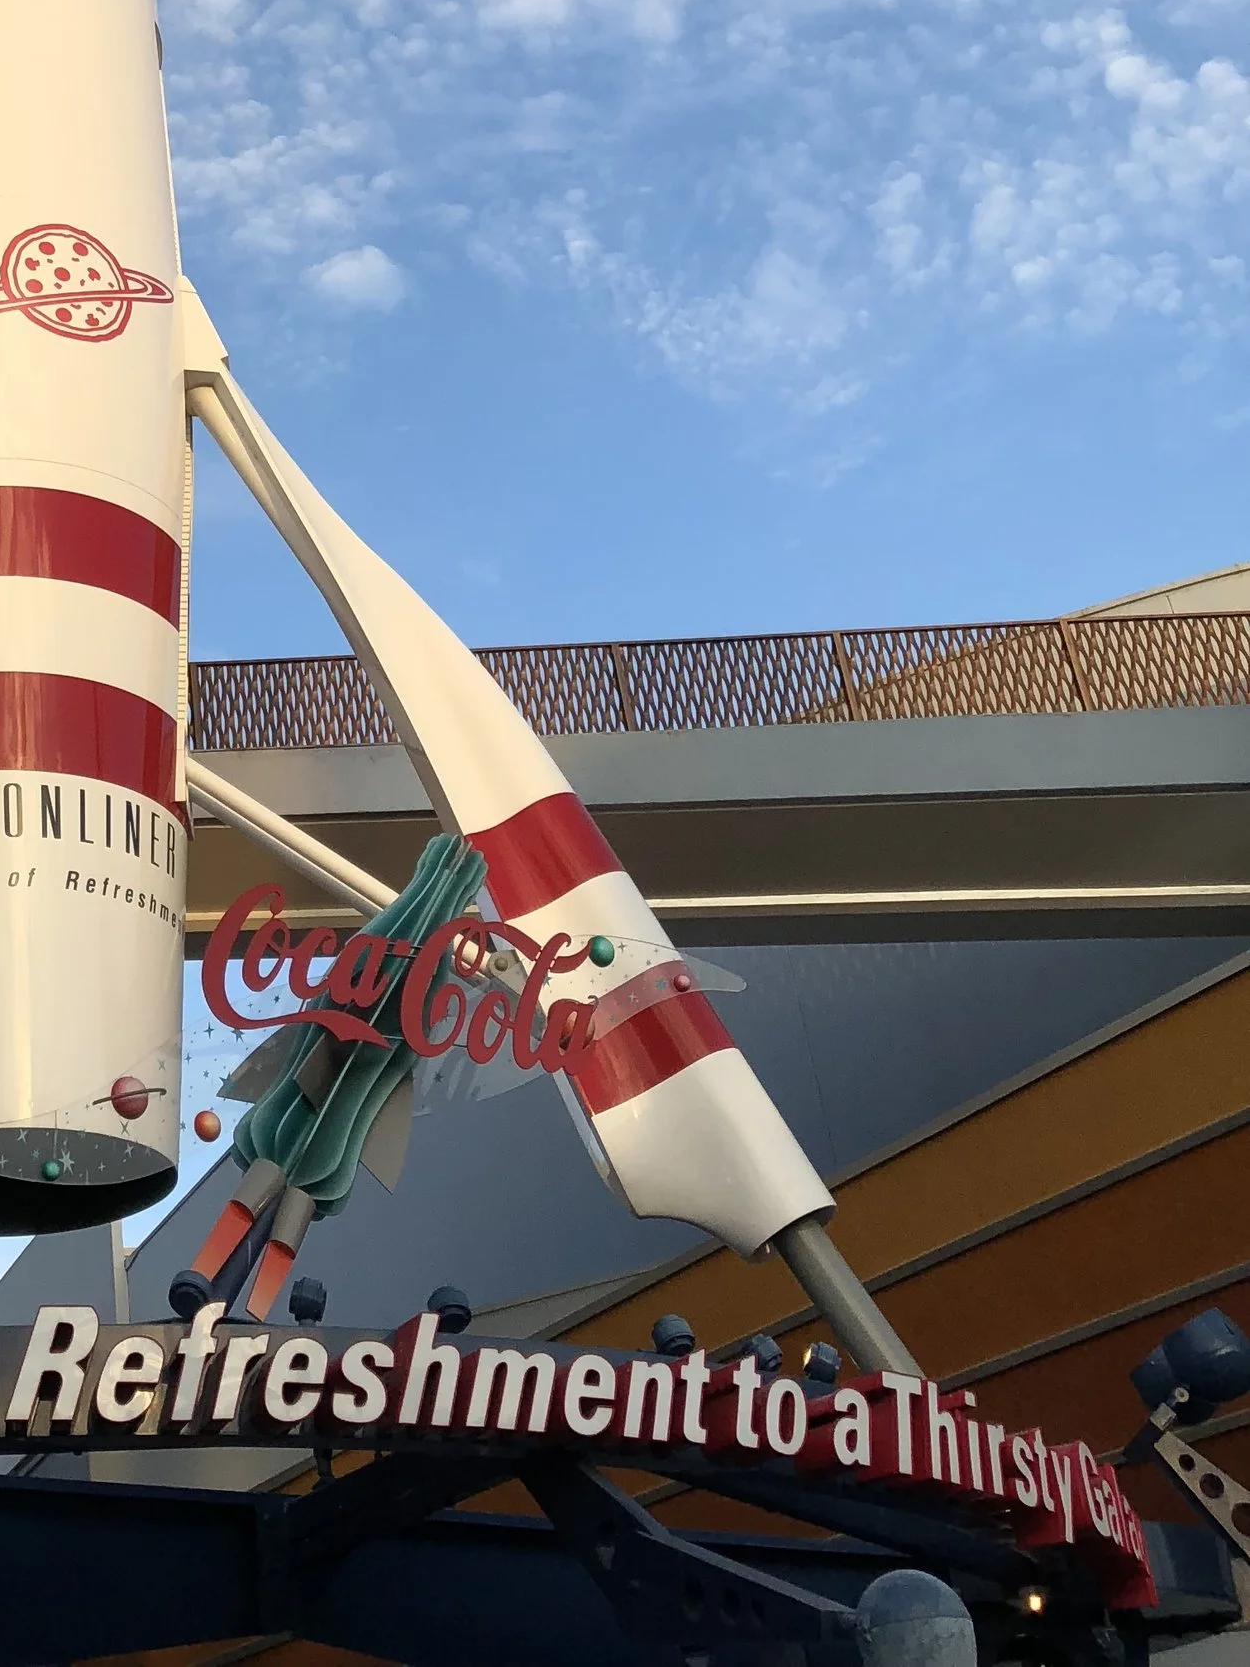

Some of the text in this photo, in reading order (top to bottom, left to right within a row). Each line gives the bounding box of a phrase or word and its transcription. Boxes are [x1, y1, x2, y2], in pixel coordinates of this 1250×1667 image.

[7, 867, 37, 889] of
[65, 871, 185, 940] Refreshme
[4, 1300, 709, 1445] Refreshment
[732, 1354, 807, 1456] to
[833, 1392, 871, 1467] a
[881, 1371, 1075, 1544] Thirsty
[1078, 1441, 1150, 1574] Gala
